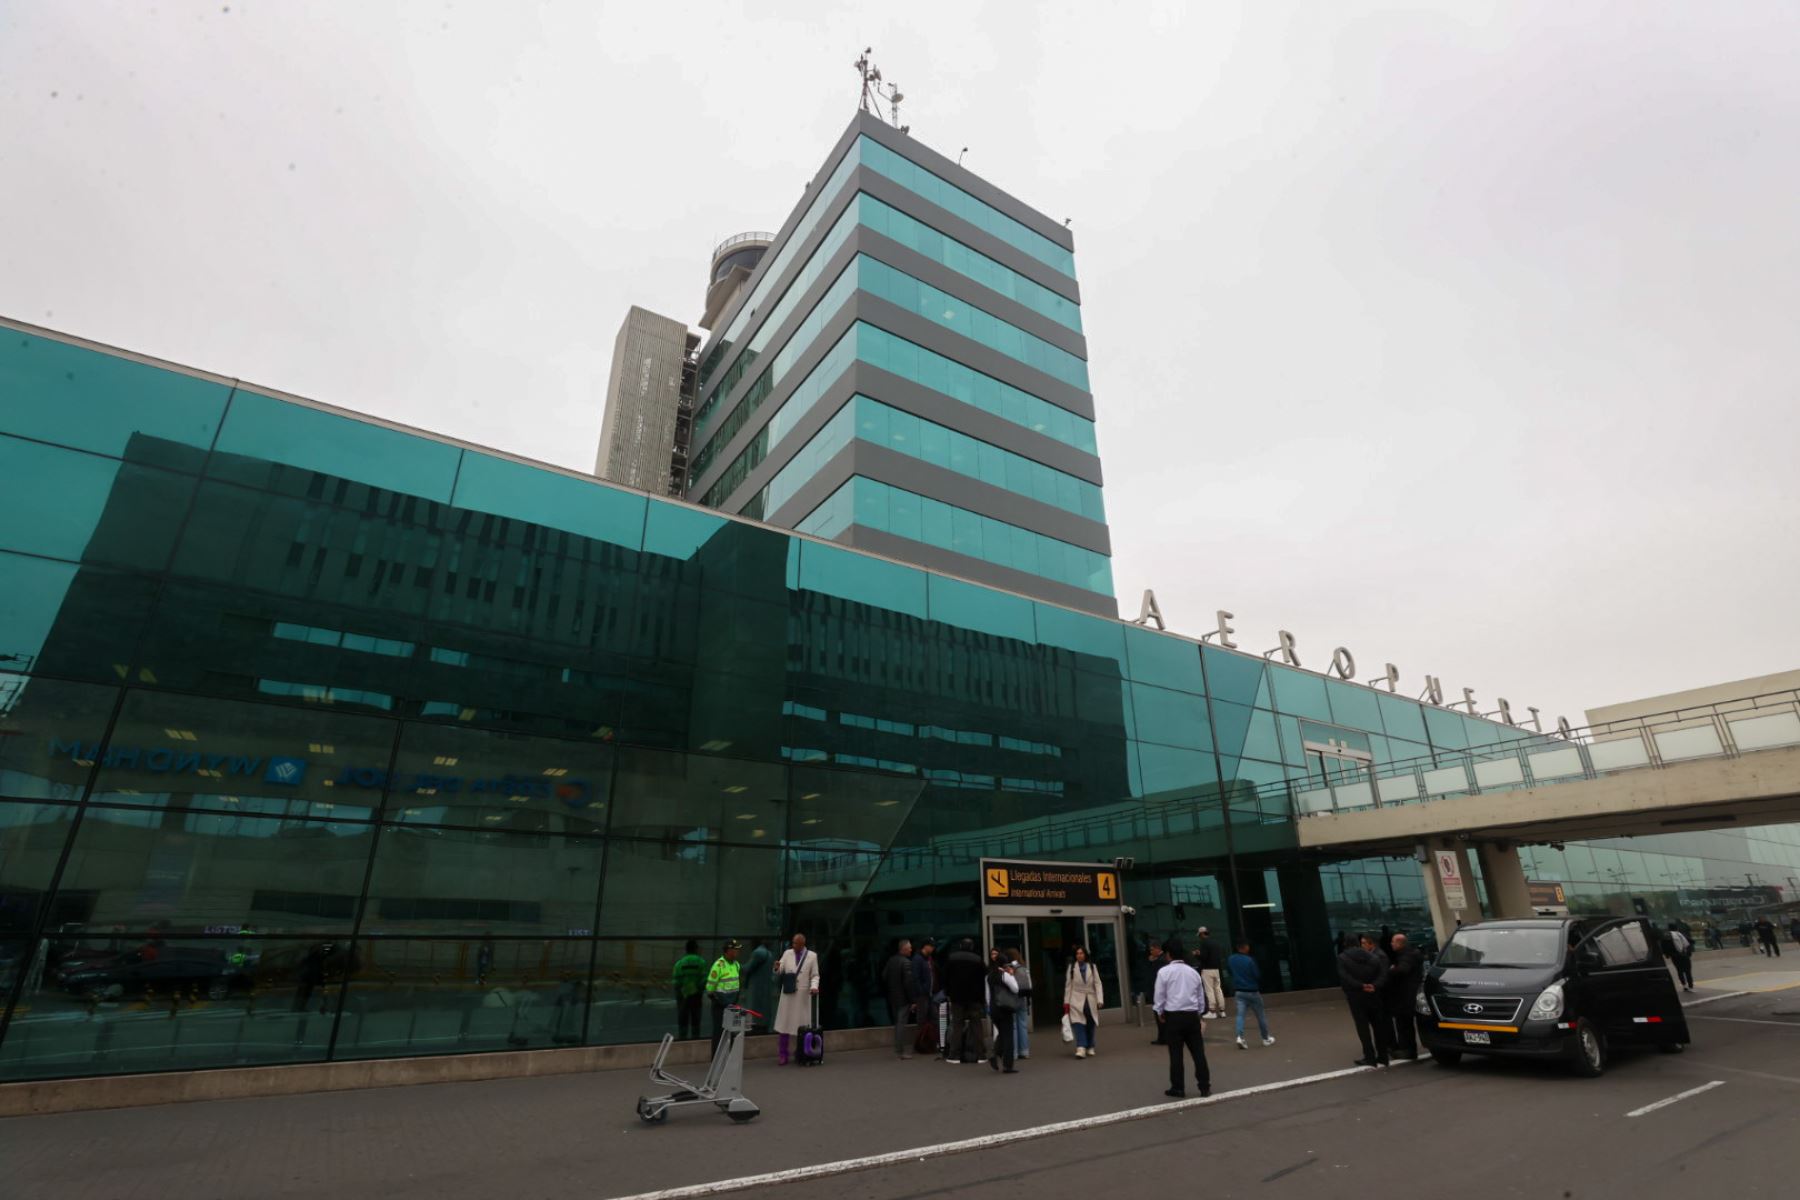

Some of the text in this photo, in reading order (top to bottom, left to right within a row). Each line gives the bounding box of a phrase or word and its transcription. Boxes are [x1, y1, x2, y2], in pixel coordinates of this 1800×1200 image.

[1139, 588, 1570, 739] AEROPUERTO
[1043, 871, 1092, 884] Internacionales
[1103, 876, 1110, 896] 4
